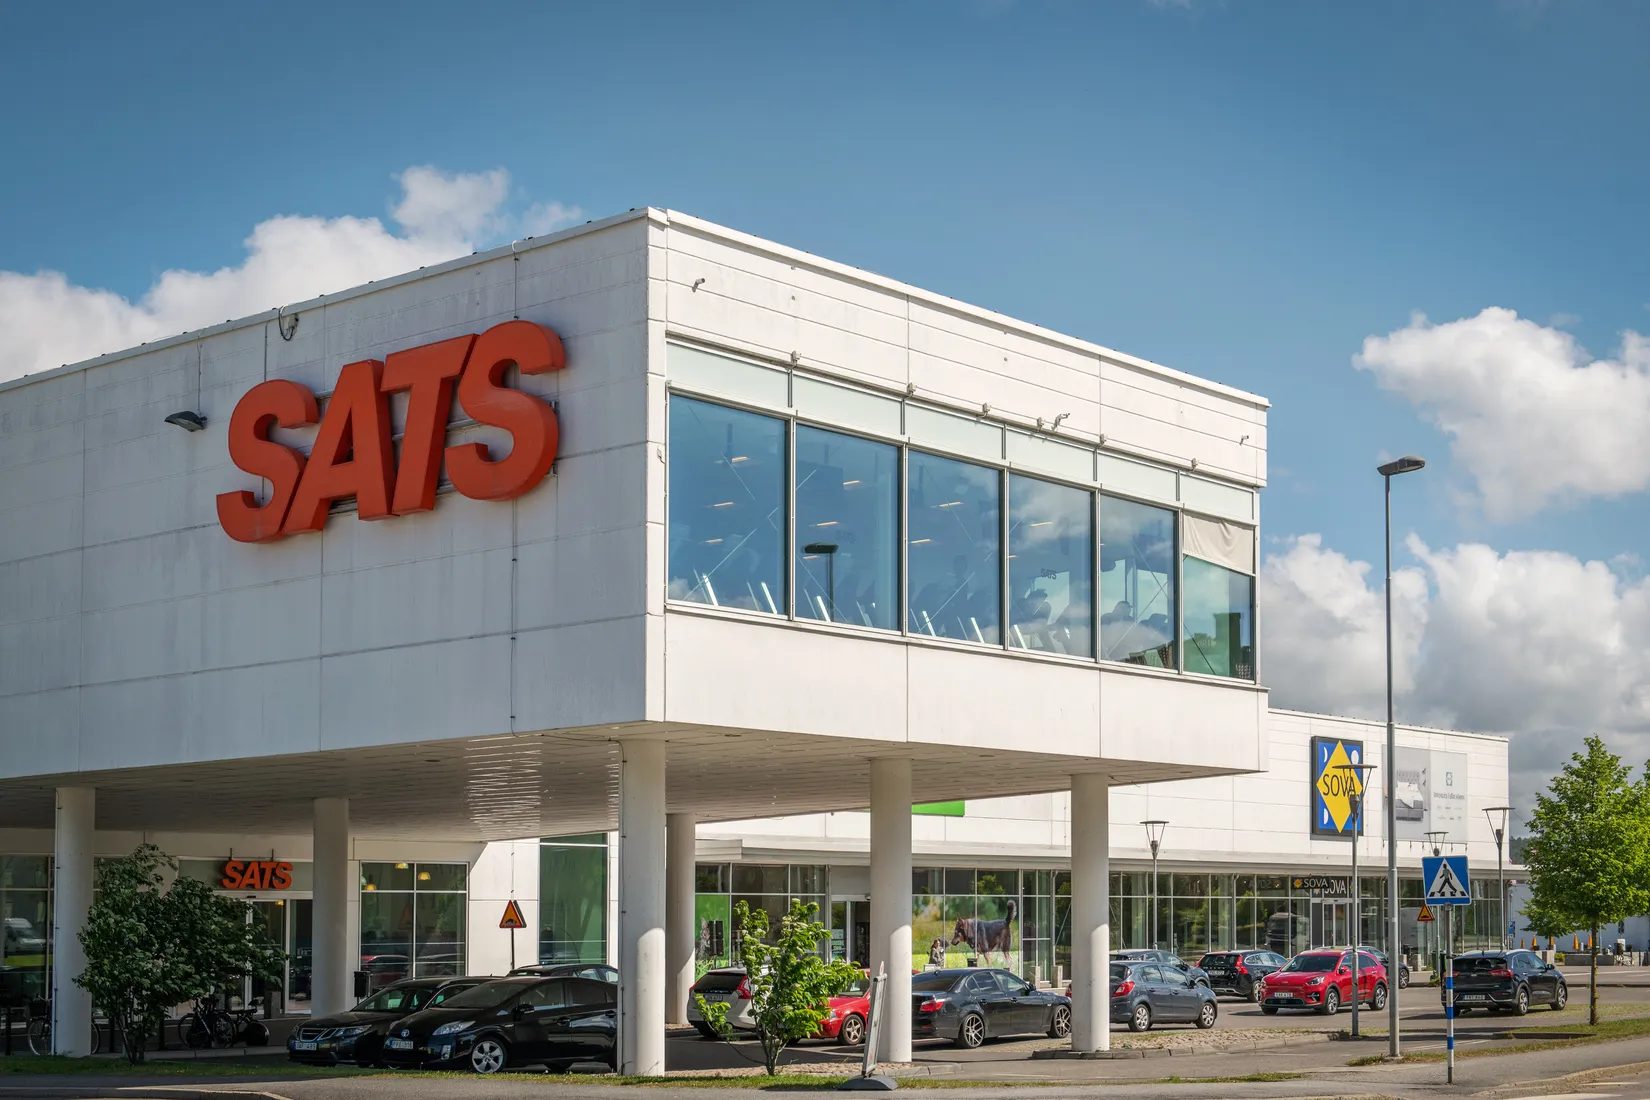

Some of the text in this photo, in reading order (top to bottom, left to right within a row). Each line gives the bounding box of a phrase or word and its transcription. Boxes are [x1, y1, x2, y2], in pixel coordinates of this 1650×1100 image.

[216, 319, 566, 544] SATS
[1322, 773, 1357, 797] SOVA
[222, 860, 294, 890] SATS
[1303, 878, 1328, 890] SOVA
[1324, 880, 1347, 894] OVA
